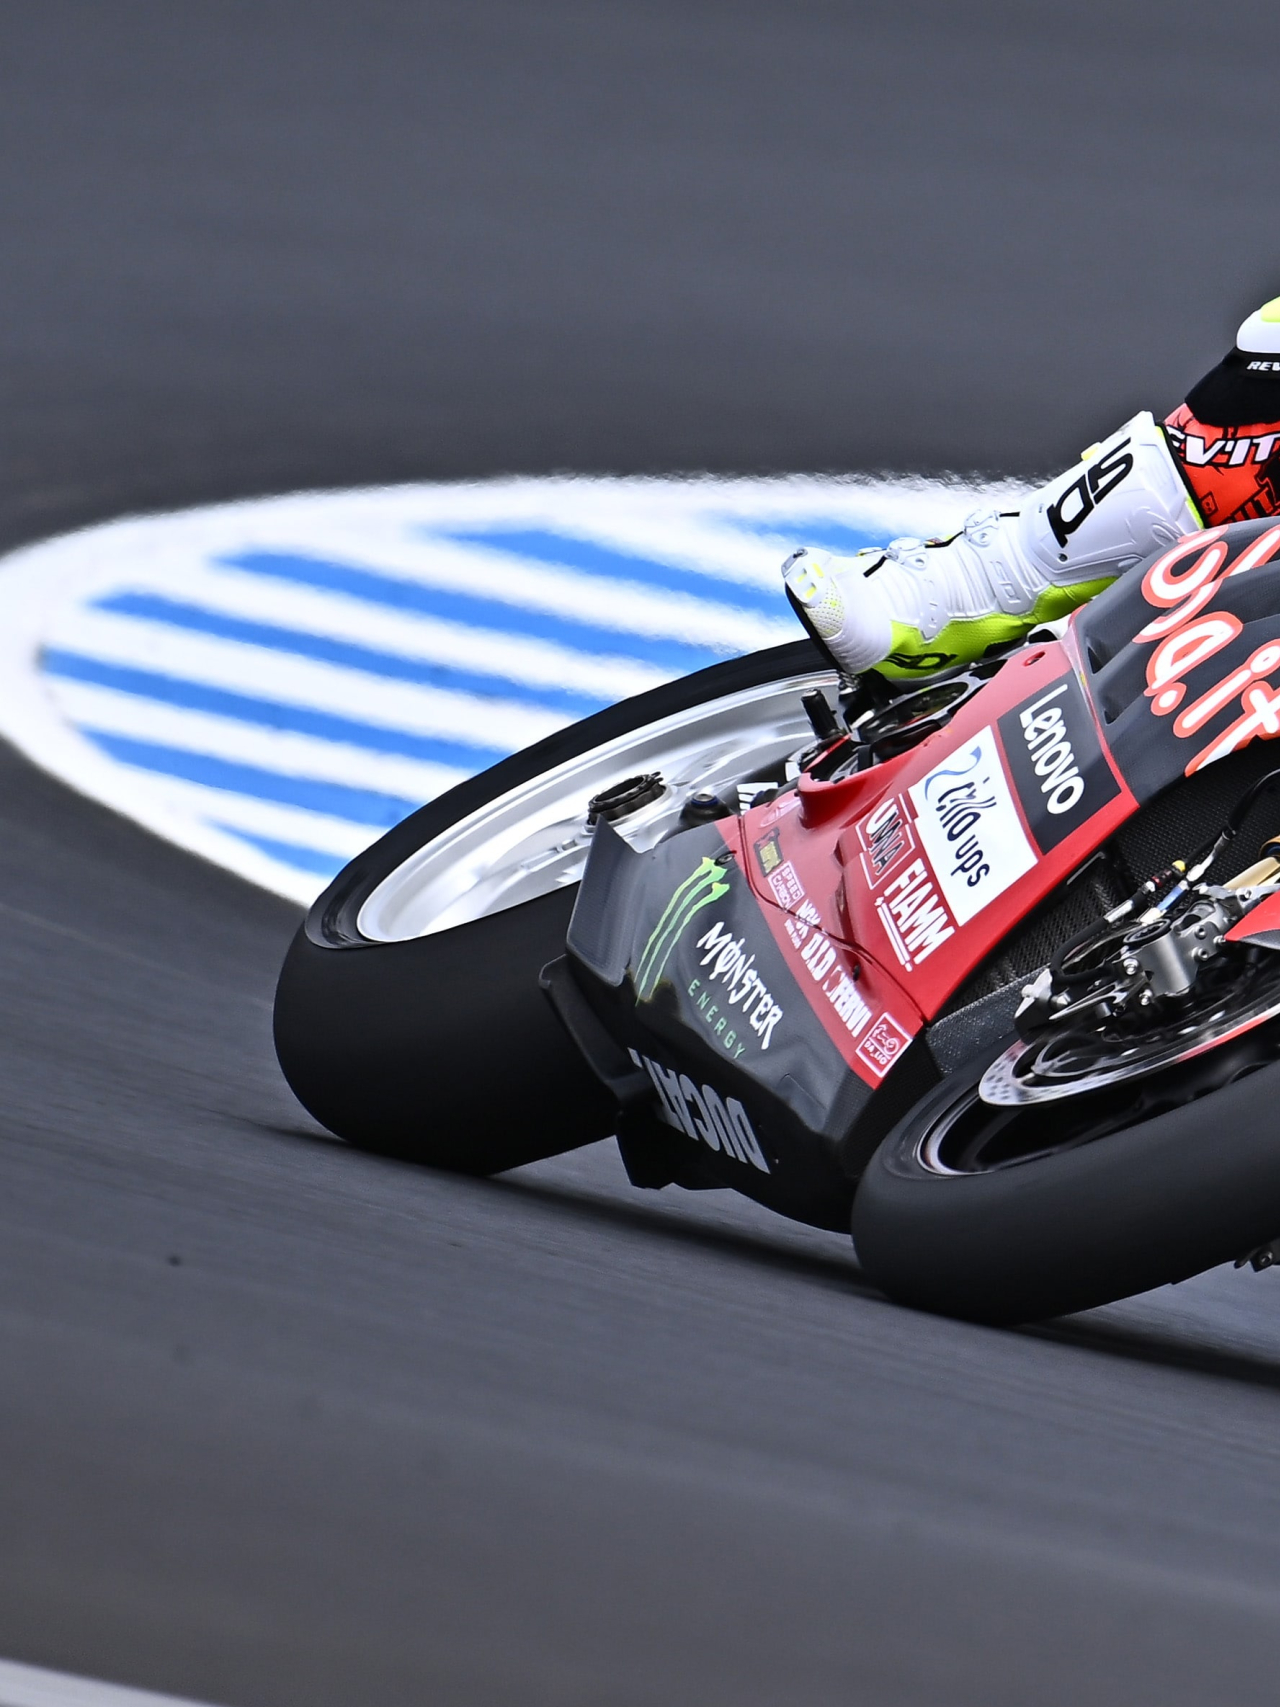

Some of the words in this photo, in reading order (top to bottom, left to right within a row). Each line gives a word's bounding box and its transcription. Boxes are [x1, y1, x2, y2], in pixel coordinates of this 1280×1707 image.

[1019, 684, 1086, 816] Lenovo
[781, 863, 803, 899] SPEED
[883, 857, 956, 968] FIAMM
[950, 834, 990, 887] ups
[686, 978, 746, 1060] ENERGY
[696, 920, 785, 1051] MONSTER
[626, 1047, 771, 1175] DUCAT
